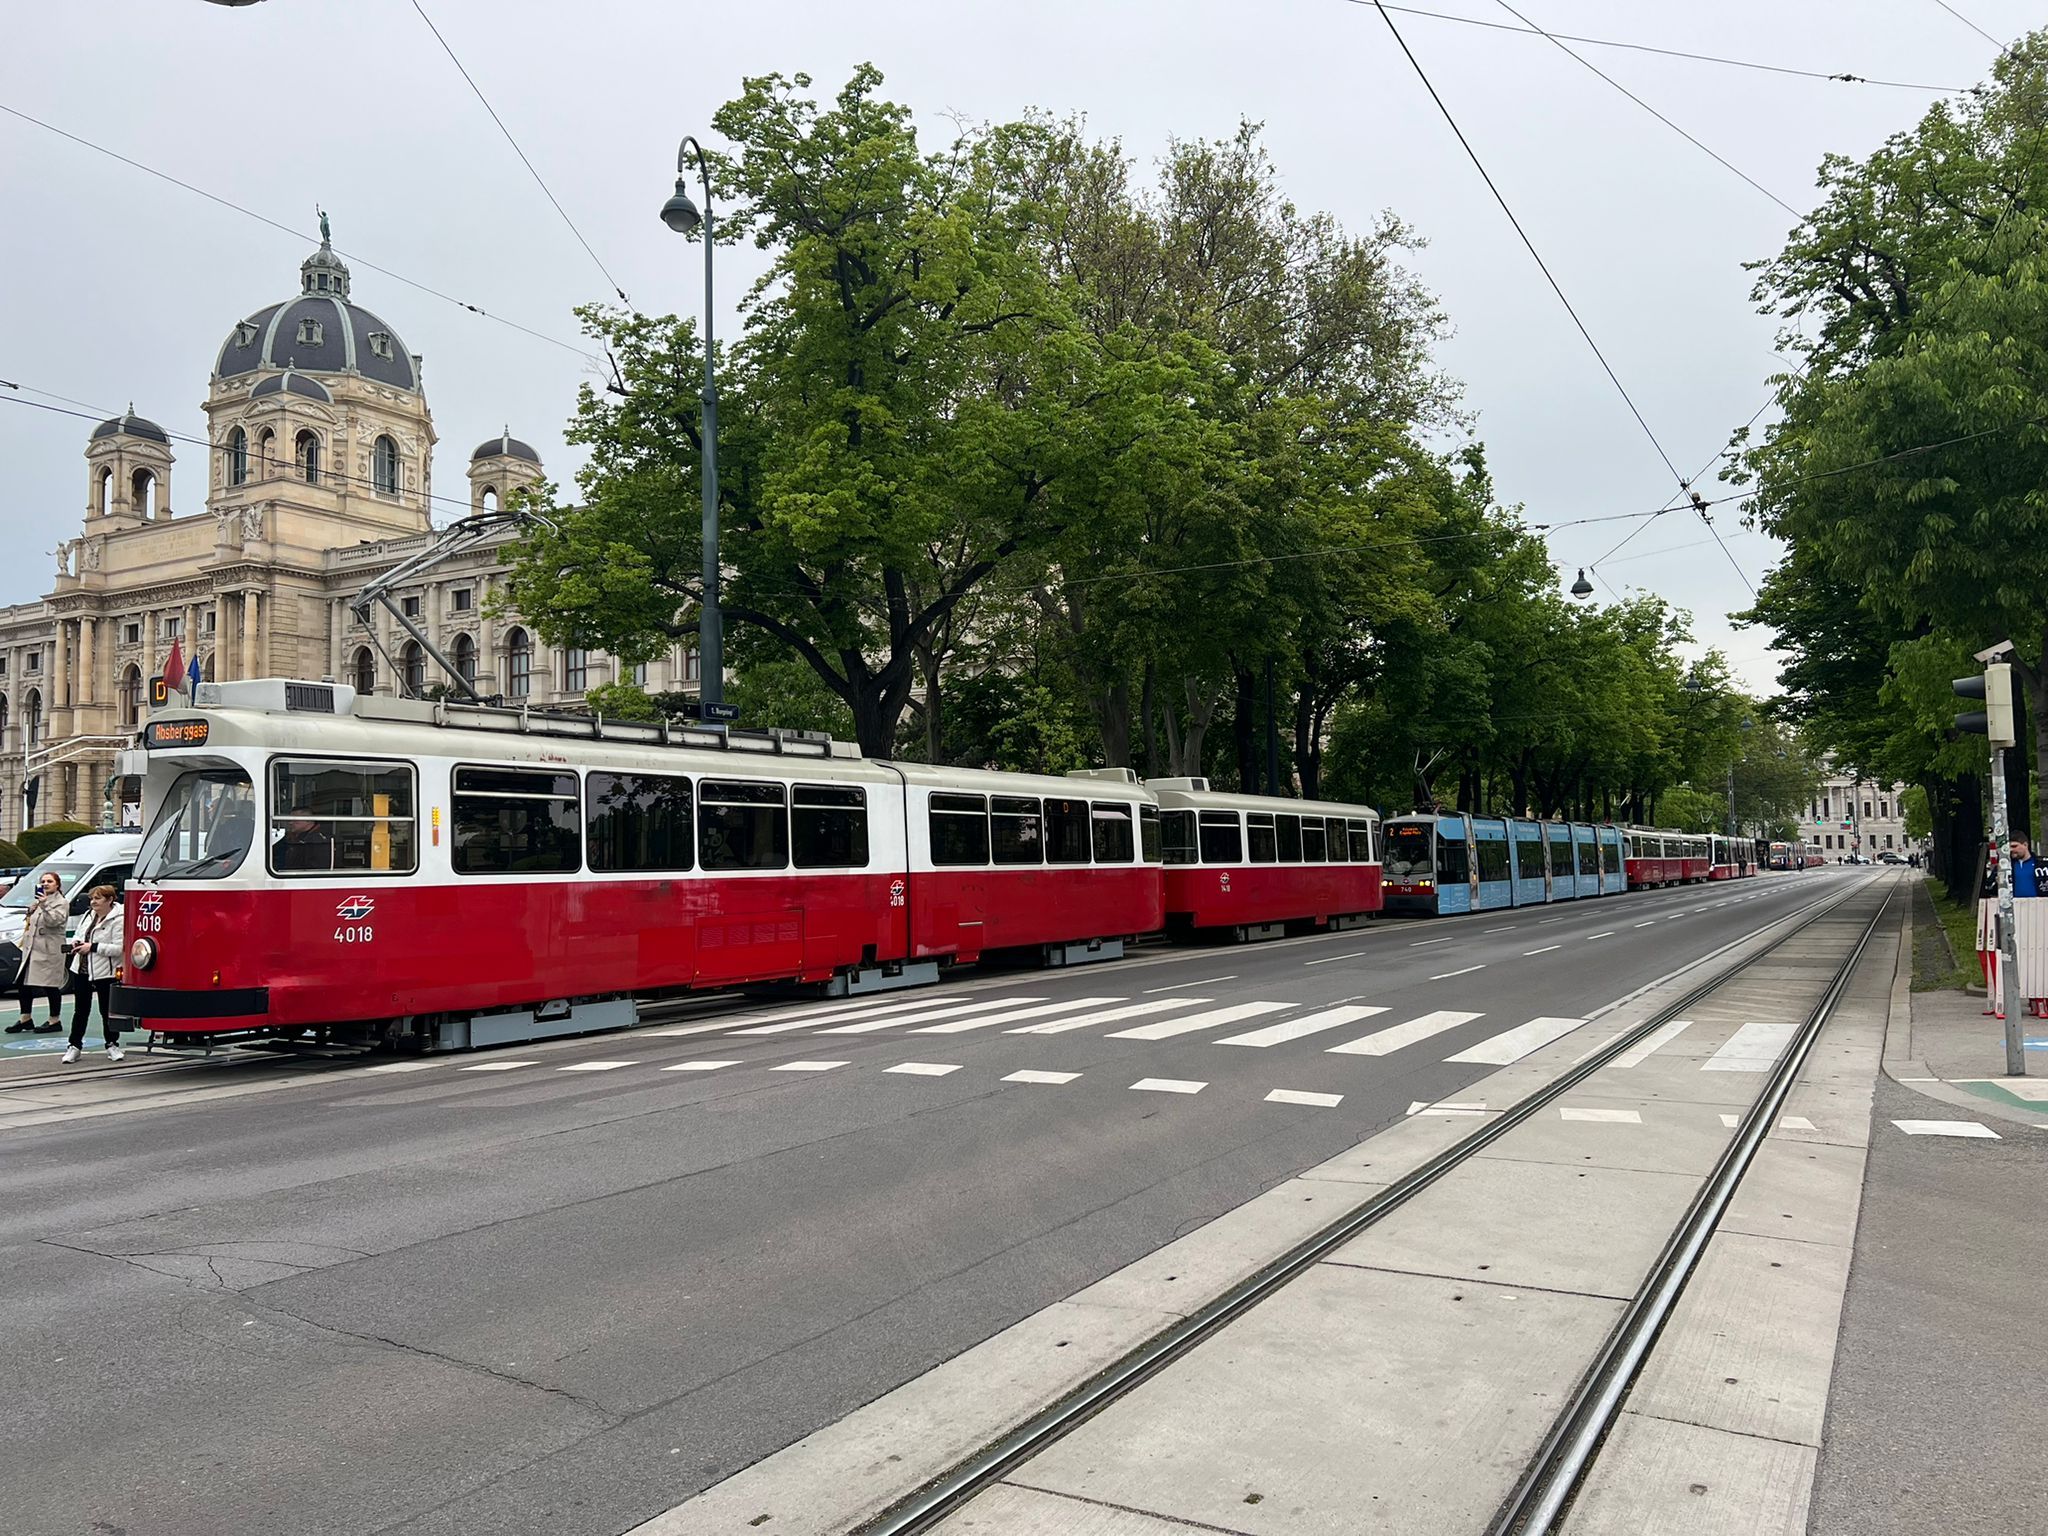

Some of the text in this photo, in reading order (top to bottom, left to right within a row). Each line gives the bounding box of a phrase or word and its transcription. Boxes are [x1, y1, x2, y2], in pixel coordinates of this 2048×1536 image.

[156, 681, 166, 700] D
[1390, 828, 1395, 837] 2
[890, 895, 905, 907] 4018
[136, 915, 161, 932] 4018
[334, 926, 373, 943] 4018
